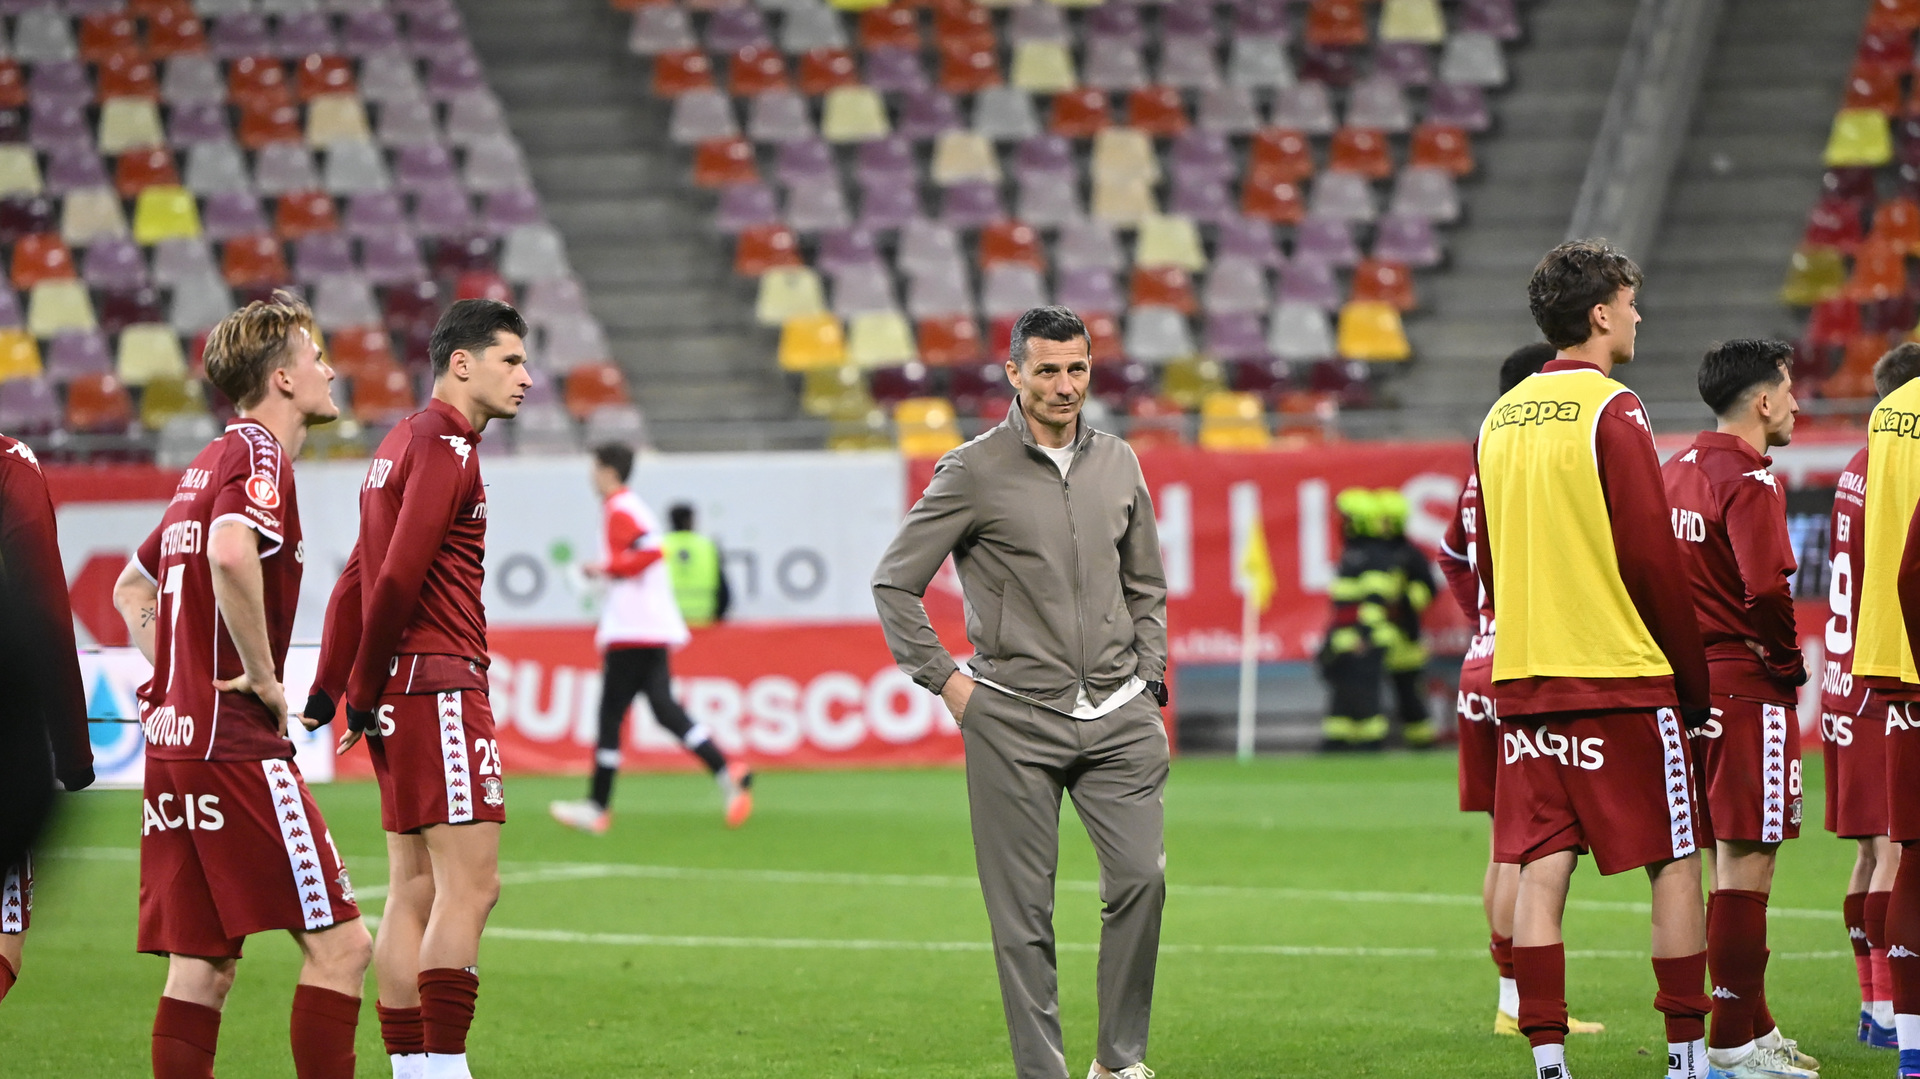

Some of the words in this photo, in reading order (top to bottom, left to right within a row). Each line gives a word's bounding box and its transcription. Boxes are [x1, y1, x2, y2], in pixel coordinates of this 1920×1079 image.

[1491, 400, 1581, 431] Kappa
[1825, 551, 1852, 655] 9
[474, 738, 502, 775] 29
[1503, 724, 1605, 771] DACRIS
[1788, 758, 1803, 796] 8
